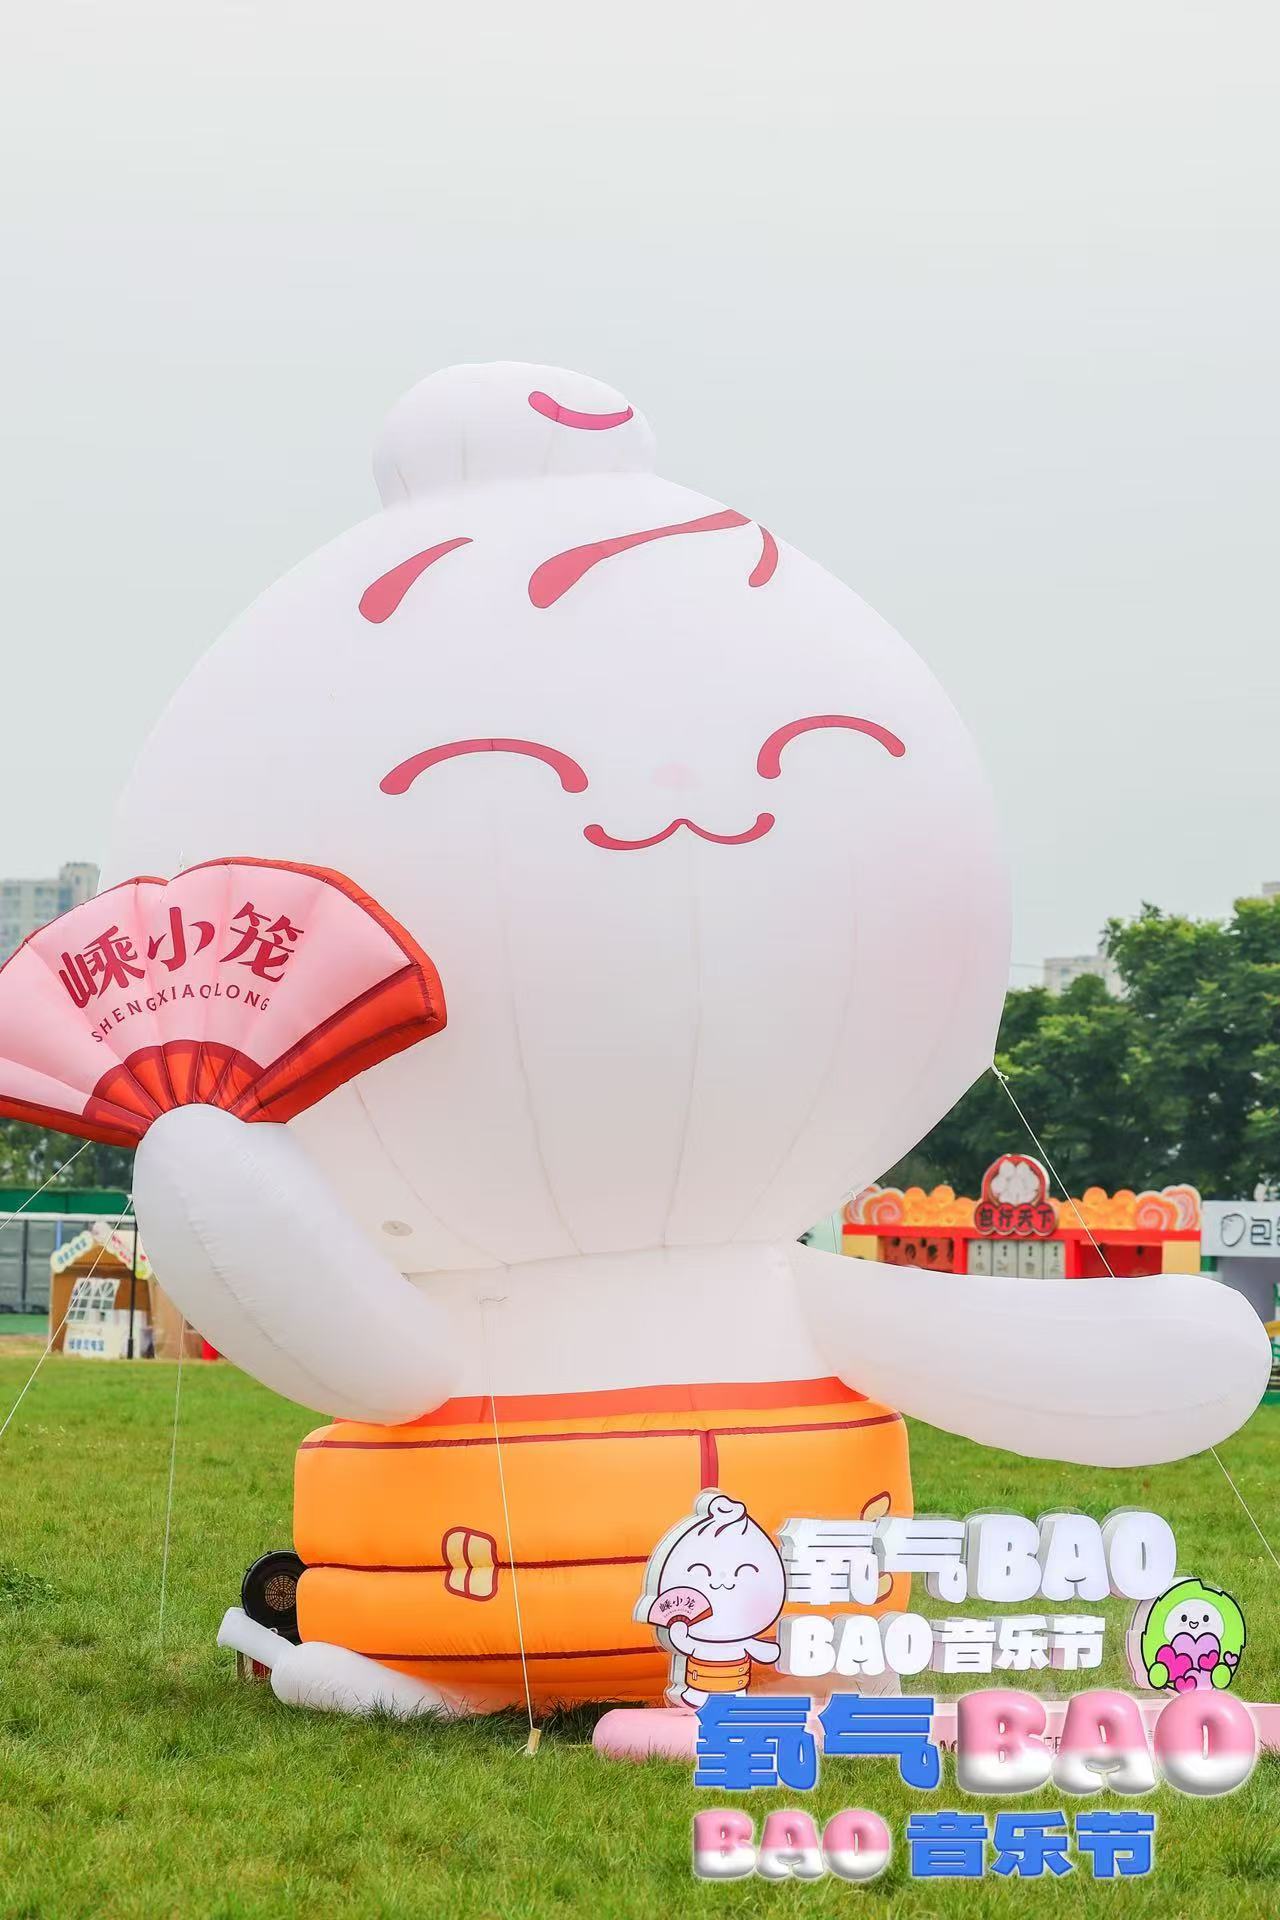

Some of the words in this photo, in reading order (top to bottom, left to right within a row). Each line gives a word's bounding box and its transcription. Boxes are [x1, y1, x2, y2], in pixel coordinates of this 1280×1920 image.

[59, 902, 304, 1008] 嵊小笼
[91, 983, 270, 1043] SHENGXIAOLONG
[1250, 1217, 1280, 1246] 包
